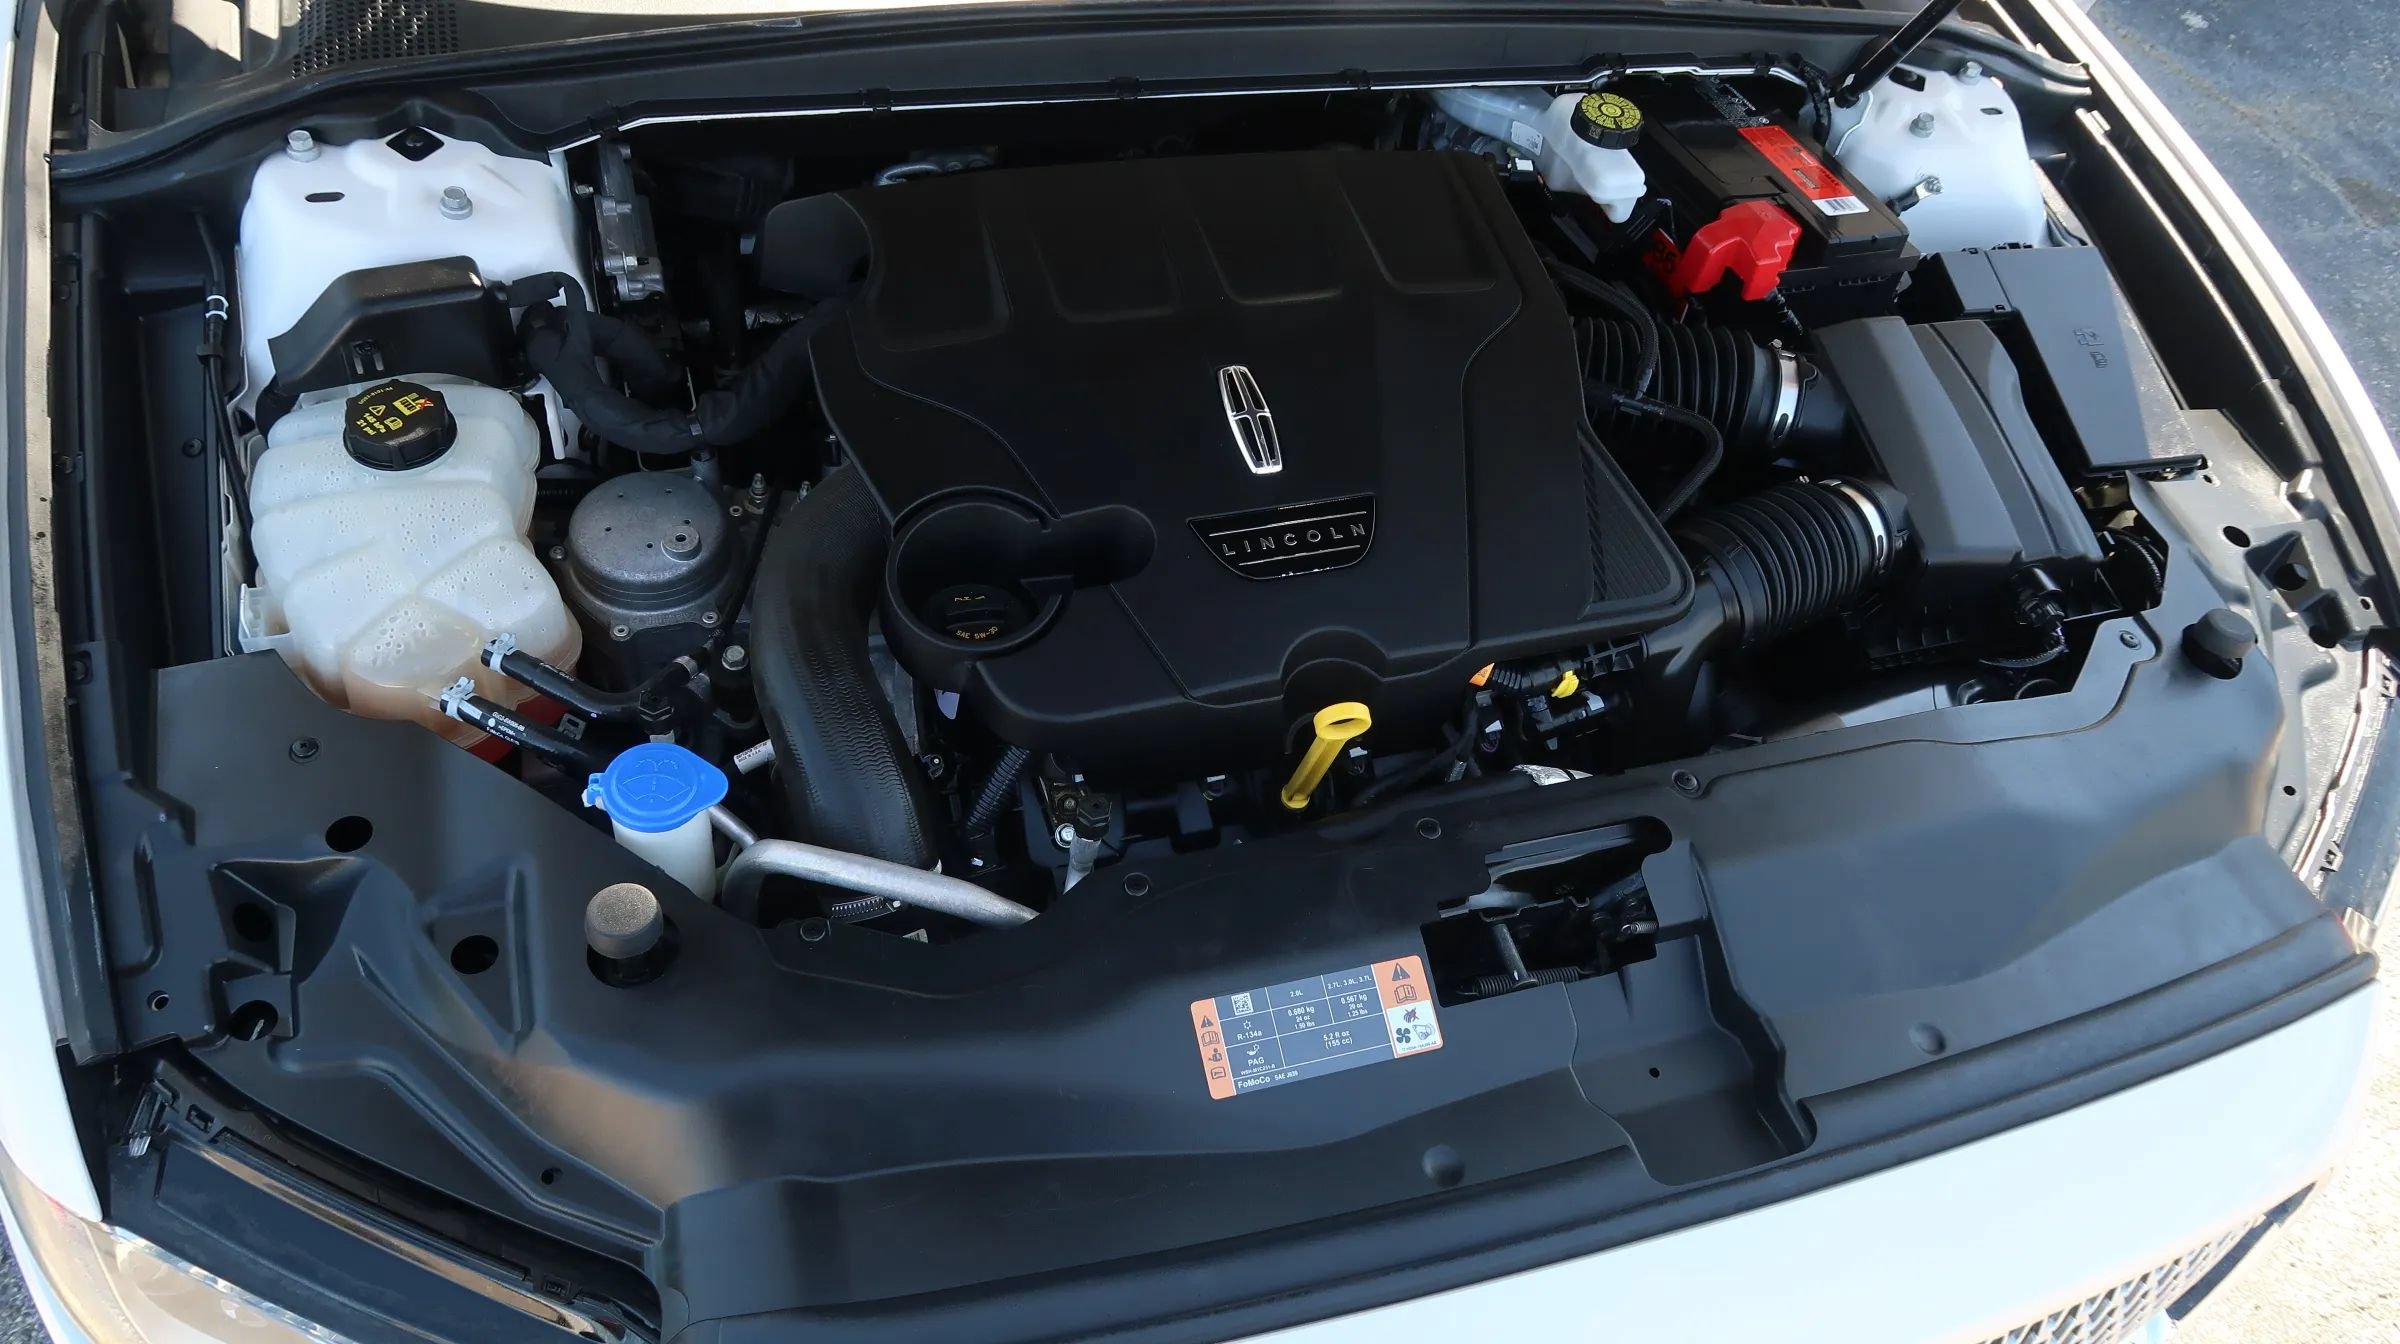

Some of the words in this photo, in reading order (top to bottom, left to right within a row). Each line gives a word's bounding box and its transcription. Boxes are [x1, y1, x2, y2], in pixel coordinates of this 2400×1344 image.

[356, 419, 367, 428] 21
[362, 426, 377, 436] psi
[363, 412, 377, 423] 145
[373, 421, 387, 433] kPa
[1222, 523, 1366, 556] LINCOLN
[955, 629, 970, 640] SAE
[1290, 989, 1303, 998] 2.0L
[1358, 993, 1368, 1002] kg
[1287, 1008, 1305, 1017] 0.680
[1305, 1006, 1315, 1015] kg
[1237, 1031, 1262, 1041] R-134a
[1323, 1032, 1334, 1041] 5.2
[1325, 1039, 1341, 1049] (155
[1341, 1037, 1353, 1046] cc)
[1247, 1057, 1265, 1066] PAG
[1237, 1076, 1271, 1089] FoMoCo
[1274, 1073, 1286, 1081] SAE
